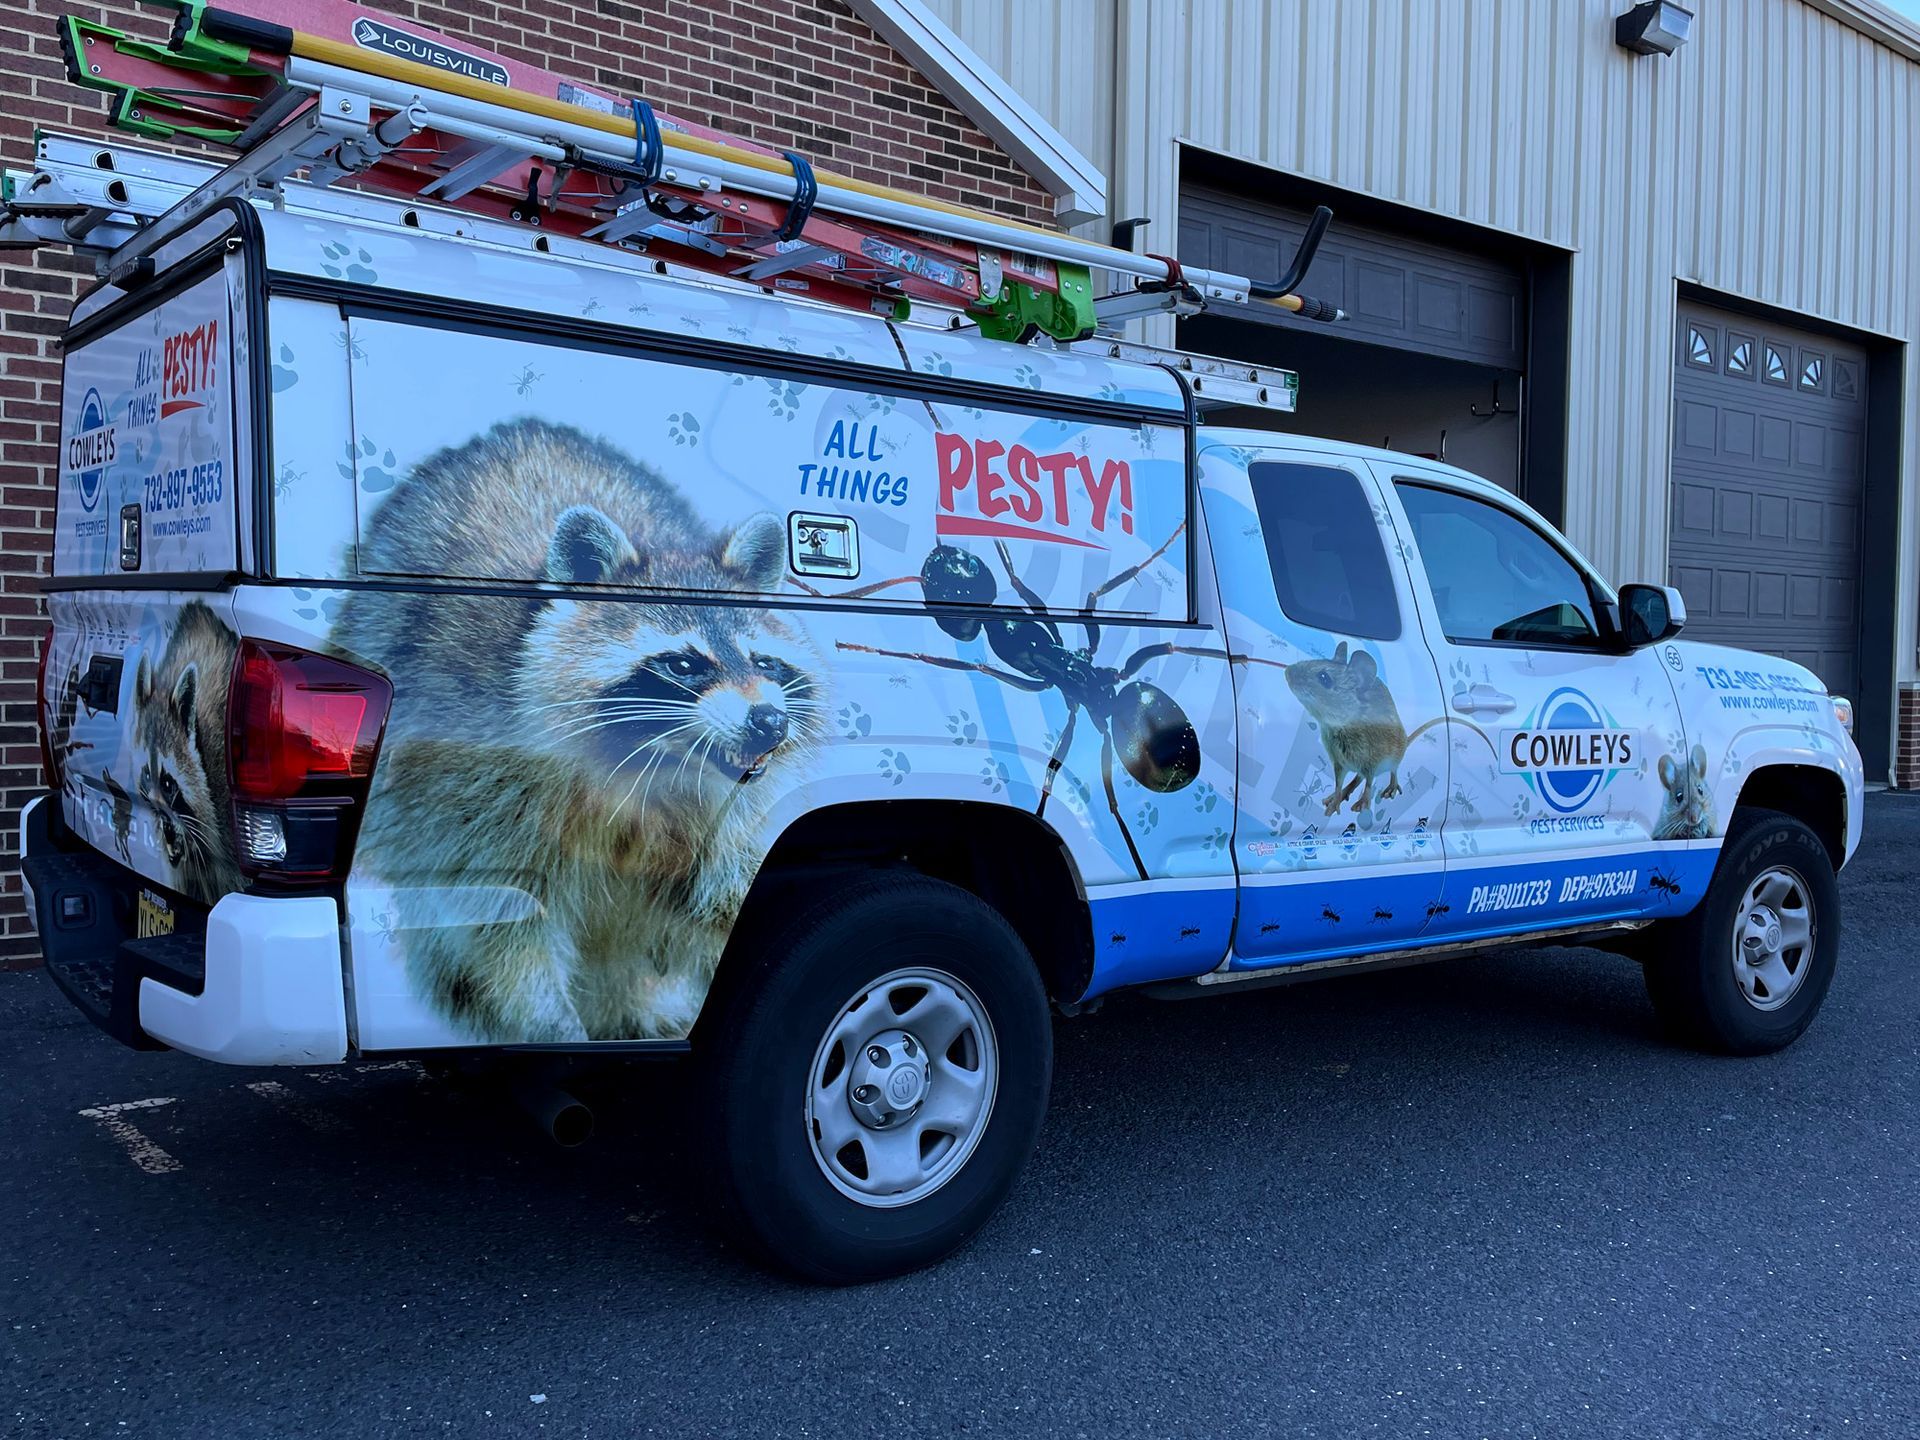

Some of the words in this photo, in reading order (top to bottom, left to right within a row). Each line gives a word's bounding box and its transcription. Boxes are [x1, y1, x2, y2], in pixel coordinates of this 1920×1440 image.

[381, 33, 505, 85] LOUISVILLE
[134, 348, 152, 389] ALL
[162, 319, 218, 399] PESTY!
[127, 393, 157, 429] THINGS
[69, 428, 115, 470] COWLEYS
[823, 419, 883, 462] ALL
[144, 461, 222, 513] 732-897-9553
[798, 463, 908, 507] THINGS
[934, 431, 1133, 535] PESTY!
[152, 515, 211, 539] www.cowleys.com
[1667, 651, 1681, 666] 55
[1720, 695, 1819, 713] www.cowleys.com
[1510, 732, 1632, 768] COWLEYS
[1530, 817, 1557, 835] PEST
[1558, 815, 1605, 833] SERVICES
[1737, 830, 1789, 875] TOYO
[1467, 880, 1552, 914] PA#BU11733
[1559, 869, 1637, 903] DEP#97834A
